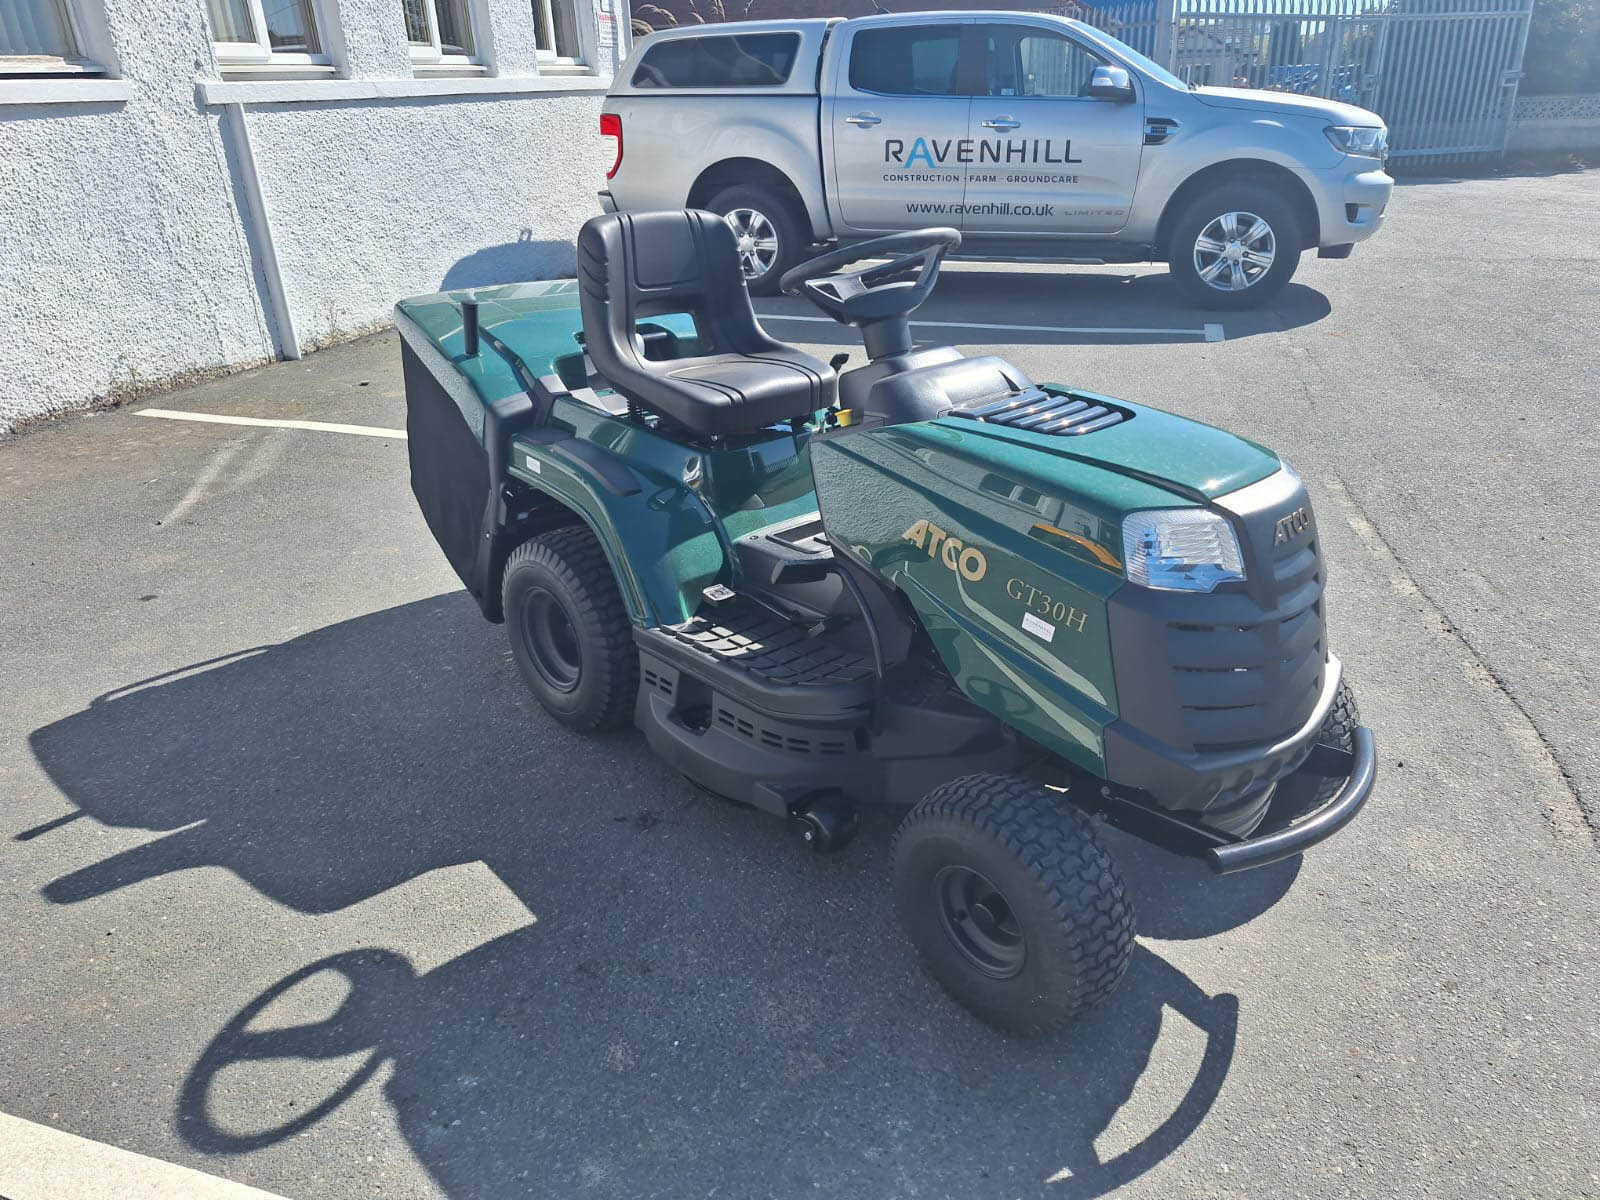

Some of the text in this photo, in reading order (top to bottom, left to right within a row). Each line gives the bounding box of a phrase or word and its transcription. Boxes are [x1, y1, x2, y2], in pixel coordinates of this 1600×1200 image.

[884, 137, 1083, 169] RAVENHILL
[882, 174, 1079, 184] CONSTRUCTION FARM GROUNDCARE
[906, 202, 1054, 217] www.ravenhill.co.uk
[1274, 507, 1308, 547] ATCO
[902, 519, 988, 583] ATCO
[1005, 577, 1089, 633] GT30H
